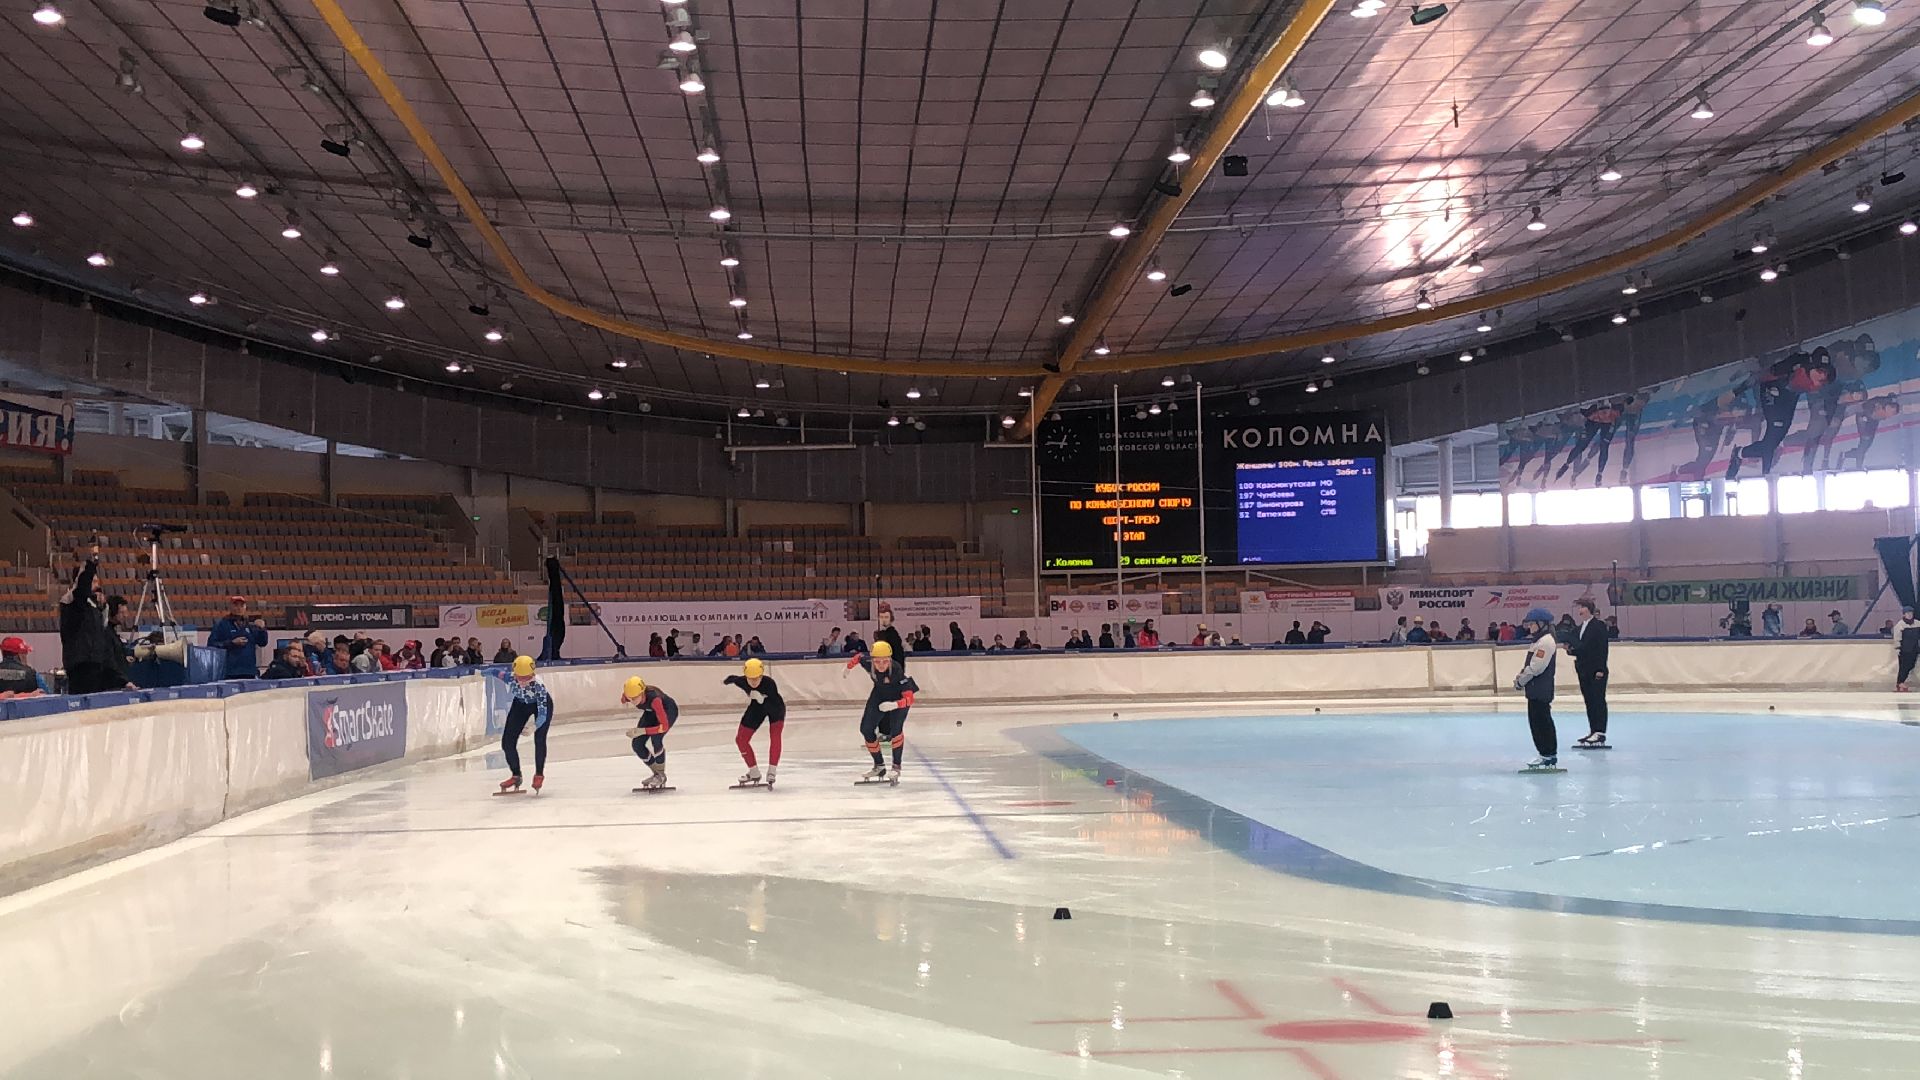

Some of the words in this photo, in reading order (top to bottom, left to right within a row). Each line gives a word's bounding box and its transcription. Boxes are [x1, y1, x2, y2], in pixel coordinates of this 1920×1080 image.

[0, 404, 73, 451] ИЯ!
[1223, 423, 1383, 449] КОЛОМНА
[1336, 468, 1359, 476] Забег
[1095, 483, 1122, 493] КУБОК
[1127, 482, 1160, 493] РОССИИ
[1239, 482, 1254, 490] 100
[1239, 492, 1253, 500] 197
[1069, 500, 1082, 510] ПО
[1086, 498, 1154, 509] КОНЬКОБЕЖНОМУ
[1159, 497, 1192, 508] СПОРТУ
[1103, 515, 1160, 525] (ШОРТ-ТРЕК)
[1123, 531, 1146, 541] ЭТАП
[1134, 555, 1177, 566] сентября
[1409, 589, 1474, 599] МИНСПОРТ
[1633, 584, 1692, 603] СПОРТ
[1781, 579, 1849, 599] ЖИЗНИ
[1418, 600, 1466, 609] РОССИИ
[311, 613, 344, 622] ВКУСНО
[361, 612, 389, 621] ТОЧКА
[481, 608, 507, 617] ВСЕГДА
[753, 610, 825, 621] ДОМИНАНТ
[615, 614, 693, 623] УПРАВЛЯЮЩАЯ
[693, 613, 749, 622] КОМПАНИЯ
[332, 699, 394, 747] SmartSkate
